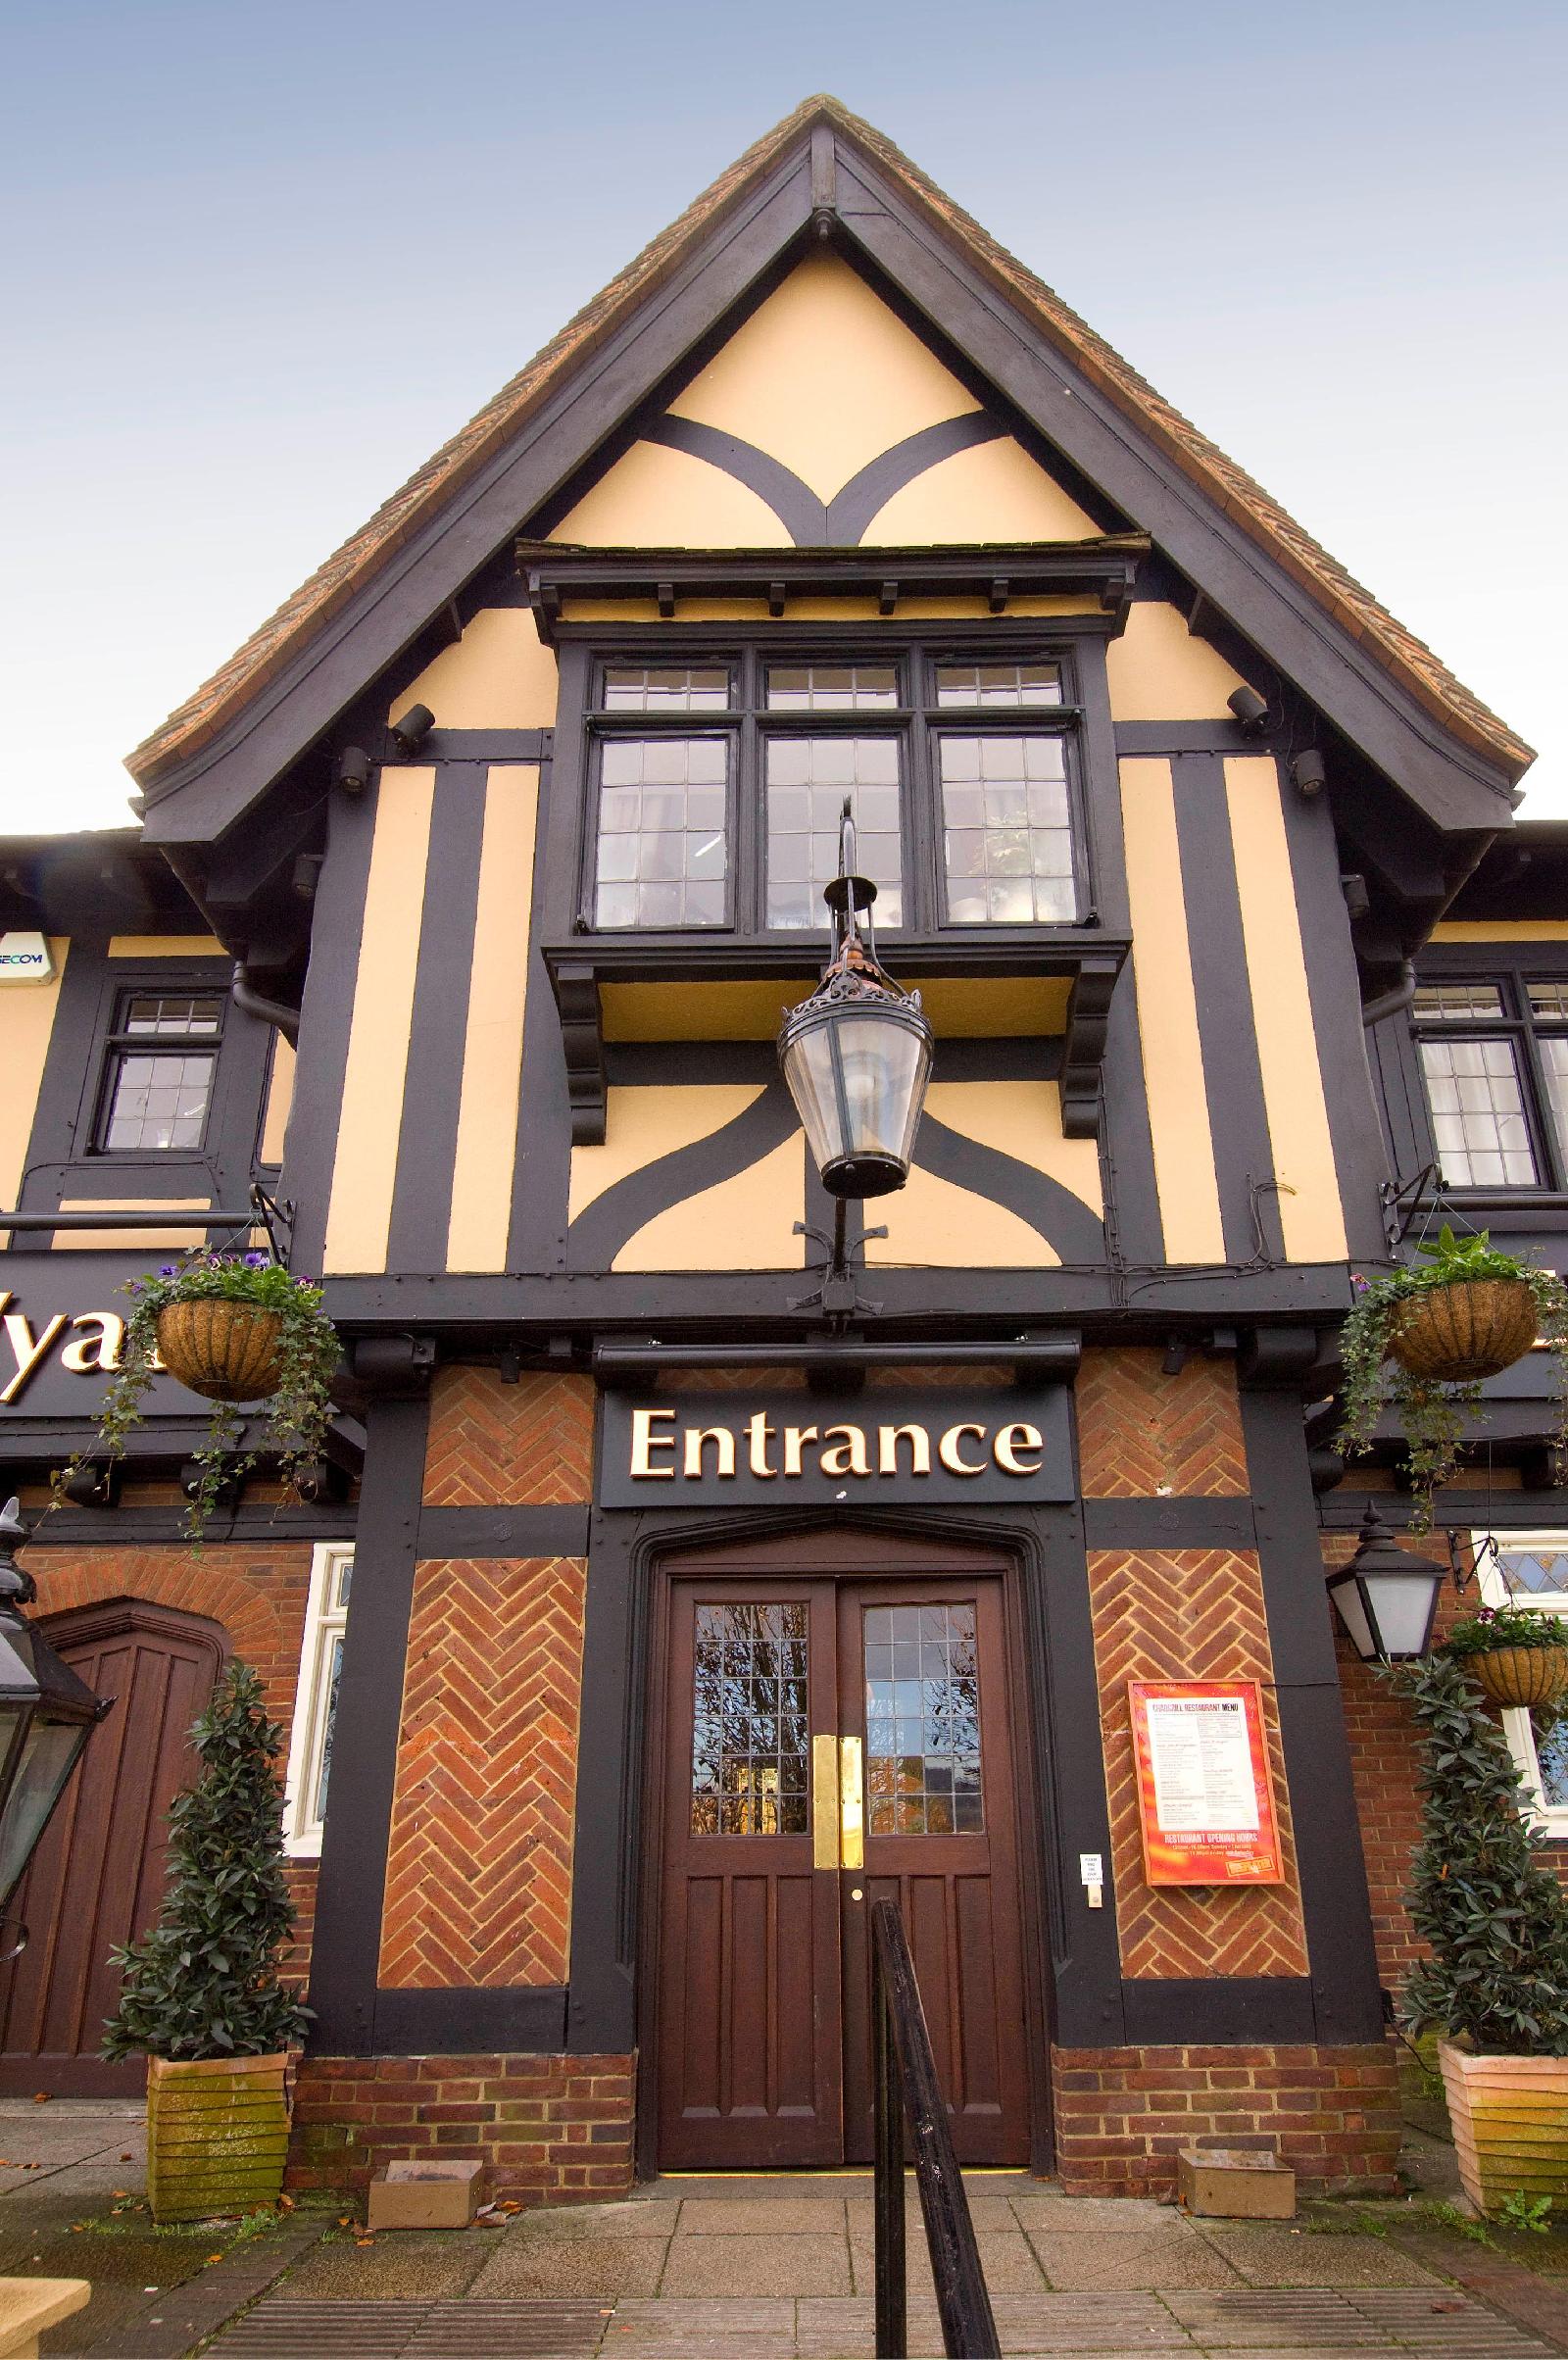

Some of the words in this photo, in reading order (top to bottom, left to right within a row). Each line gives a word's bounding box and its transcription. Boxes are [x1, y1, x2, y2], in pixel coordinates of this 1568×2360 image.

[0, 955, 42, 964] ECOM
[629, 1408, 1044, 1479] Entrance
[1184, 1703, 1220, 1712] RESTAURANT
[1222, 1703, 1239, 1712] MENU
[1164, 1834, 1205, 1844] RESTAURANT
[1206, 1833, 1235, 1844] OPENING
[1236, 1833, 1258, 1843] HOURS
